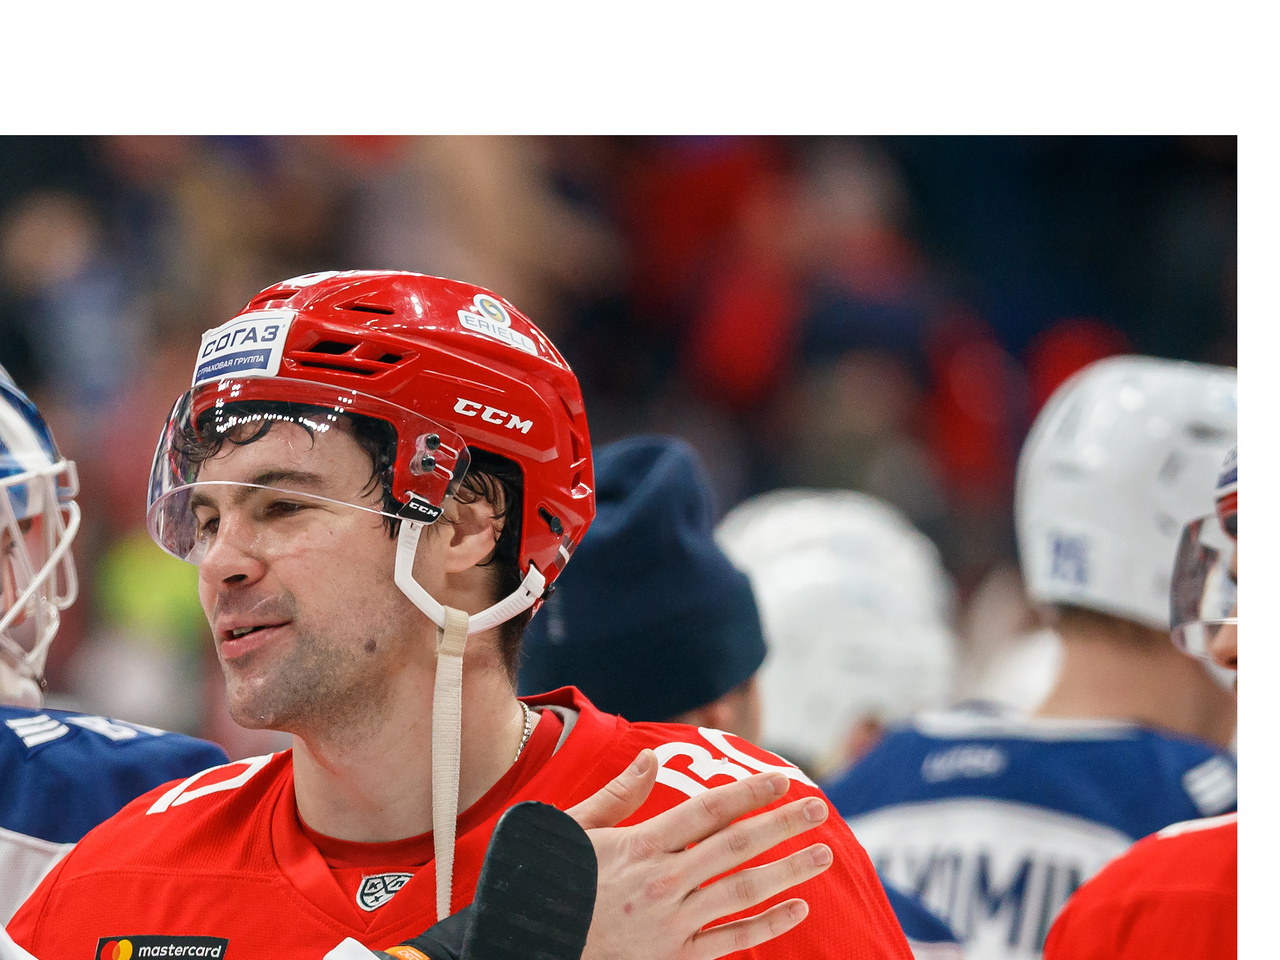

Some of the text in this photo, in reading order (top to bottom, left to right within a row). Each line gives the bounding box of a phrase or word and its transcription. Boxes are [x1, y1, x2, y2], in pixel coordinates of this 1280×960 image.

[202, 325, 280, 359] СОГАЗ
[464, 312, 533, 351] ERIELL
[197, 354, 265, 378] СТРАХОВАЯ ГРУППА
[453, 397, 533, 434] CCM
[408, 500, 439, 517] CCM
[138, 943, 221, 960] mastercard
